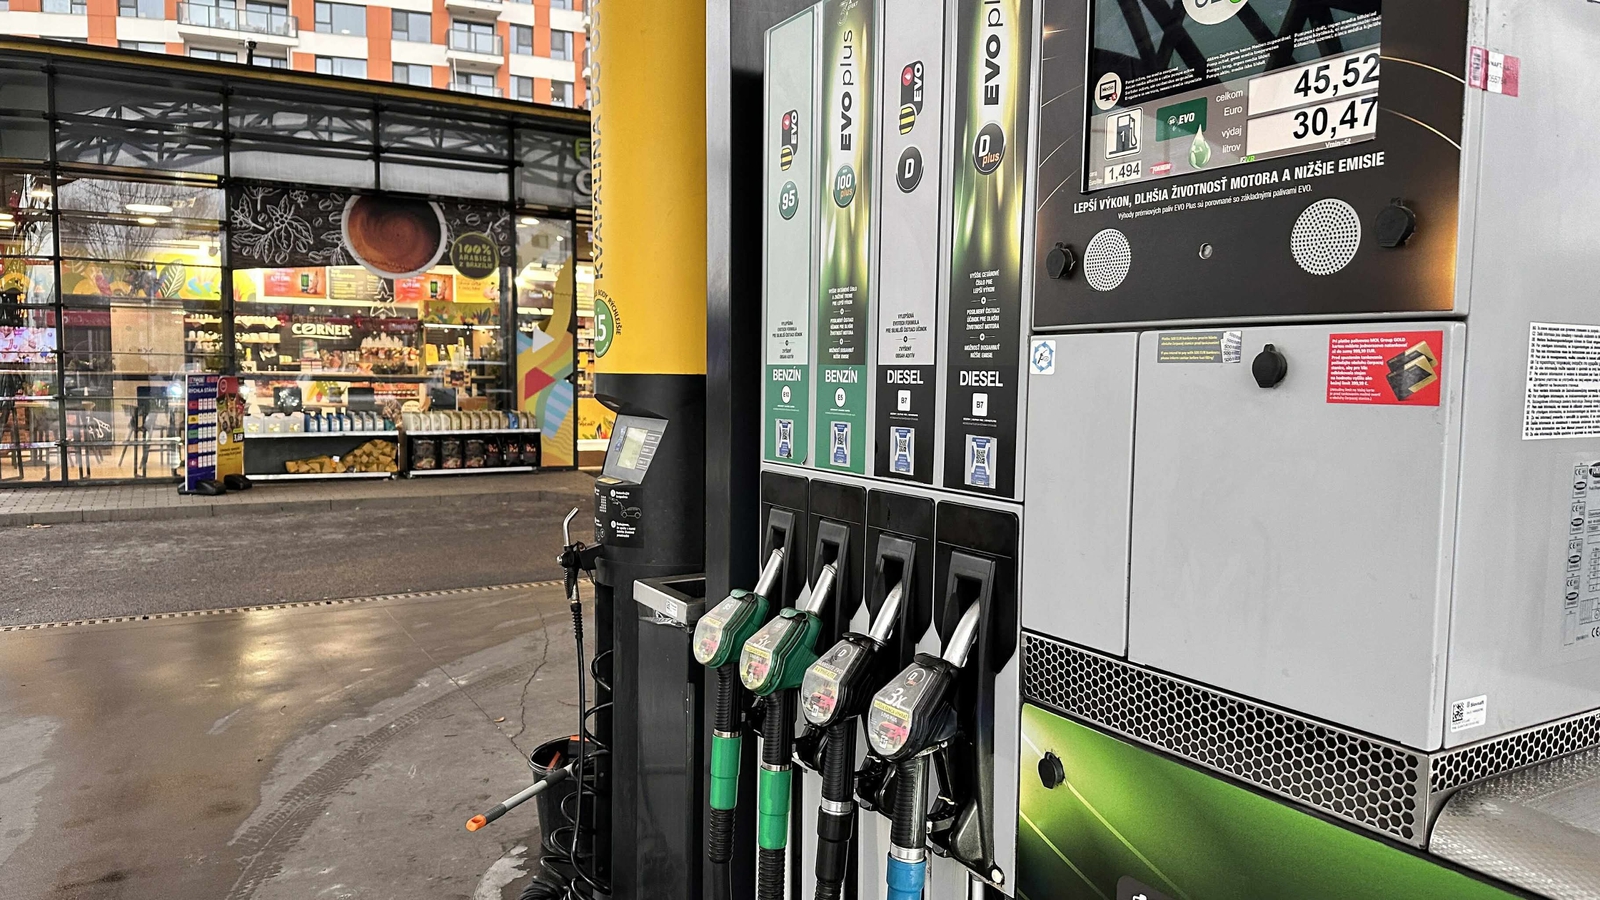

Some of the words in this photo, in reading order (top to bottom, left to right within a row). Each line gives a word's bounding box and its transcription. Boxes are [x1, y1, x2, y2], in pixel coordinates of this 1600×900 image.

[840, 29, 854, 86] plus
[984, 34, 1001, 106] EVO
[1216, 90, 1243, 102] celkom
[1294, 52, 1380, 97] 45,52
[913, 63, 923, 102] EVO
[840, 91, 853, 151] EVO
[1179, 113, 1195, 124] EVO
[1222, 126, 1242, 139] výdaj
[1293, 97, 1378, 140] 30,47
[1224, 106, 1243, 117] Euro
[790, 112, 798, 145] EVO
[1120, 130, 1125, 142] 1
[978, 134, 991, 158] D
[1222, 142, 1241, 153] litrov
[904, 158, 915, 179] D
[982, 152, 1000, 167] plus
[837, 174, 852, 190] 100
[1108, 162, 1141, 182] 1,494
[1074, 199, 1097, 214] LEPŠÍ
[1099, 196, 1132, 210] VÝKON,
[1135, 191, 1168, 205] DLHŠIA
[1171, 177, 1228, 199] ŽIVOTNOSŤ
[1230, 170, 1279, 190] MOTORA
[1281, 168, 1291, 182] A
[1295, 161, 1335, 180] NIŽŠIE
[1338, 152, 1385, 173] EMISIE
[592, 115, 604, 280] KVAPALINA
[782, 190, 796, 210] 95
[1174, 204, 1185, 212] EVO
[1185, 202, 1197, 210] Plus
[1298, 184, 1313, 194] EVO.
[458, 244, 492, 255] 100%
[292, 323, 350, 336] CORNER
[773, 366, 801, 381] BENZÍN
[825, 367, 858, 384] BENZÍN
[887, 370, 924, 384] DIESEL
[960, 371, 1004, 387] DIESEL
[976, 401, 984, 409] B7
[886, 688, 908, 708] 3x
